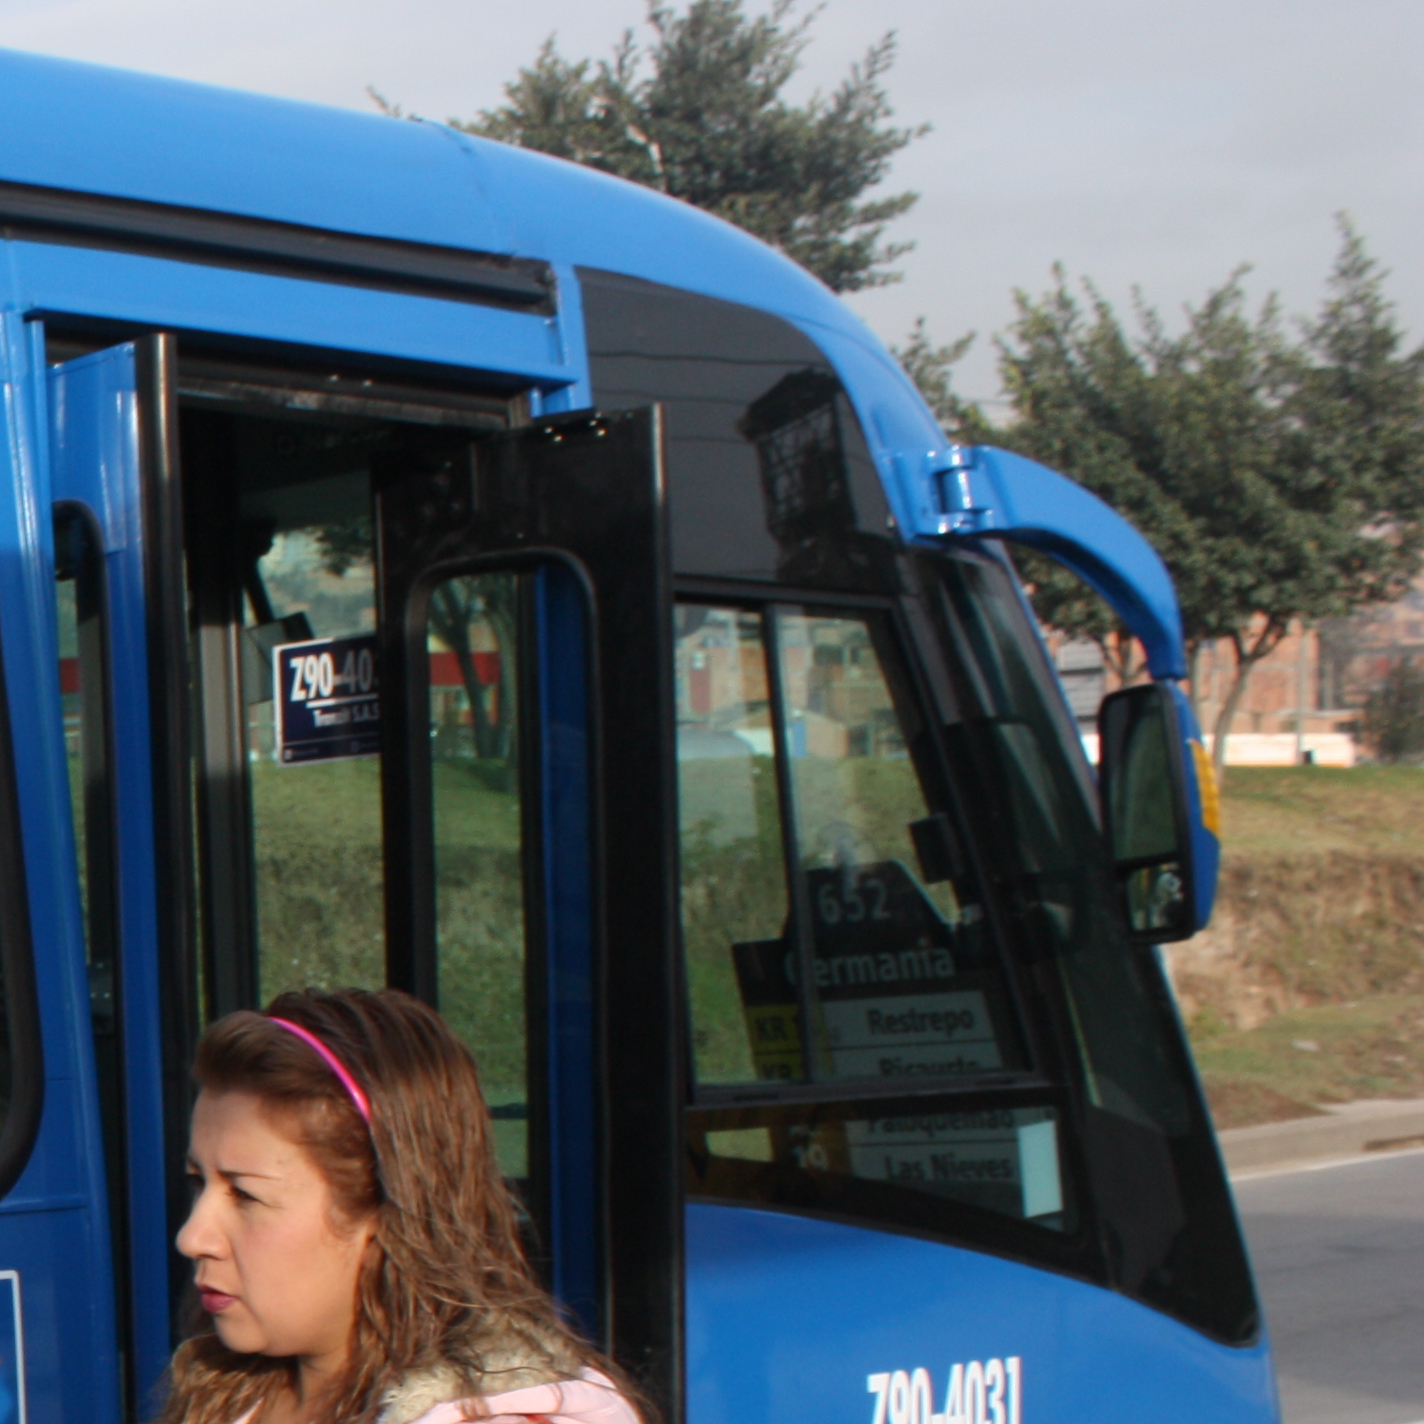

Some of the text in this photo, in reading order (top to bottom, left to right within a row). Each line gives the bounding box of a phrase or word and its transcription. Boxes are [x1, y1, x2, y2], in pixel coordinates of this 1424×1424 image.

[289, 648, 380, 703] Z90-40
[816, 877, 893, 926] 652
[866, 1007, 975, 1039] Restrepo
[883, 1153, 925, 1181] Las
[930, 1151, 1014, 1180] Nieves
